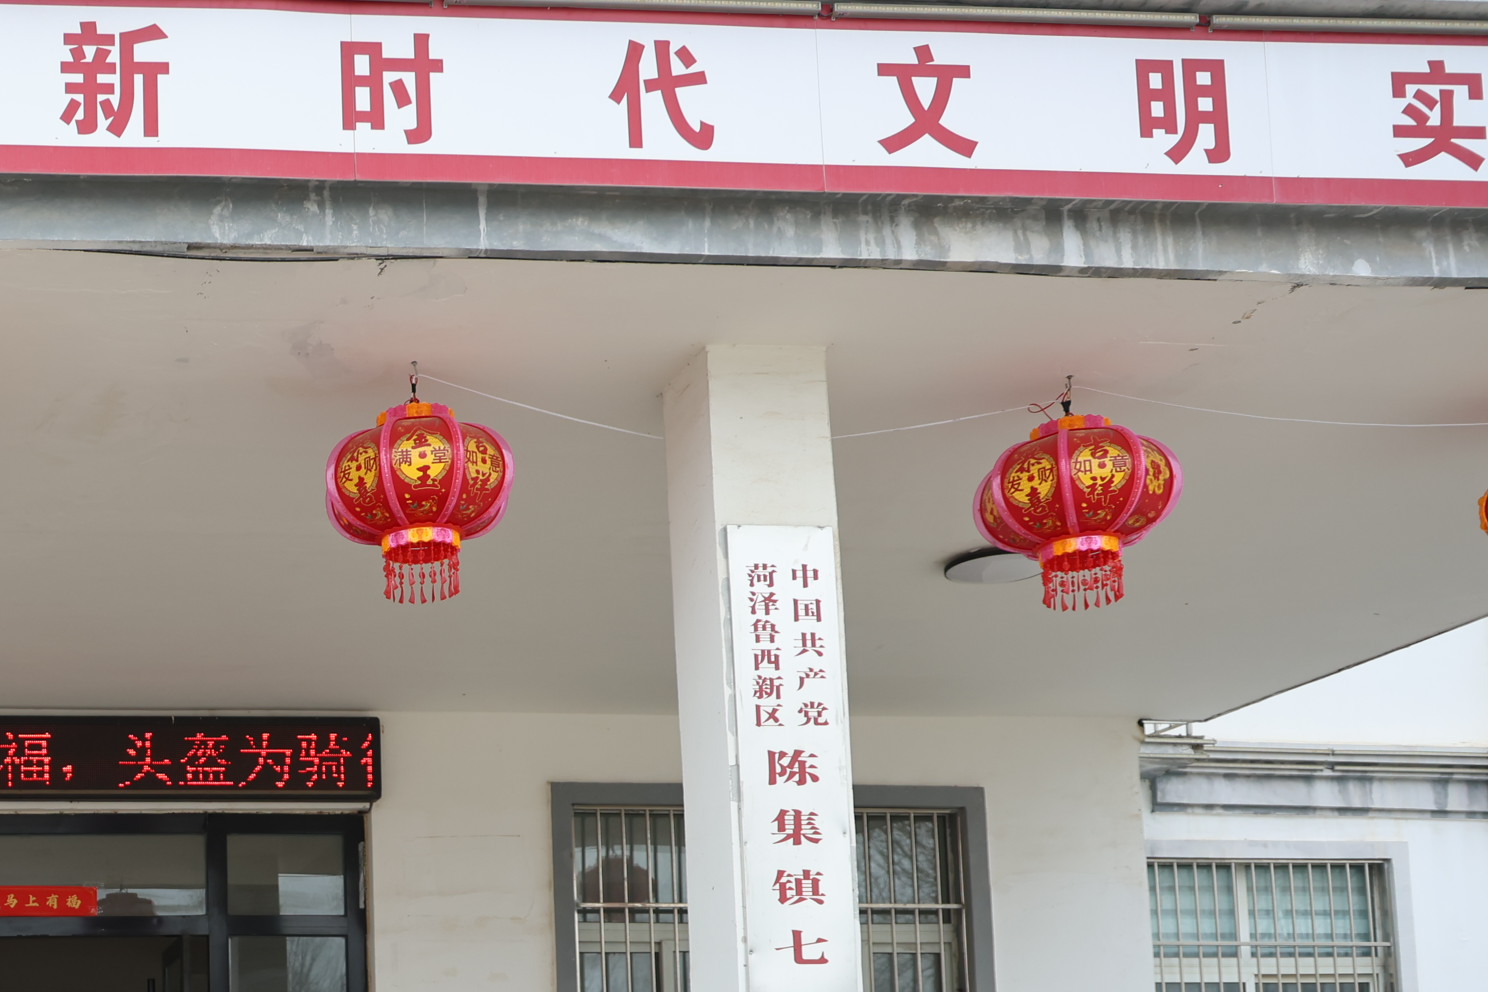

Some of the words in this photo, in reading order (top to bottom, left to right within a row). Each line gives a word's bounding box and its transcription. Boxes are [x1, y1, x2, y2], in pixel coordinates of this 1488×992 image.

[745, 562, 785, 728] 菏泽鲁西新区
[791, 563, 830, 727] 中国共产党
